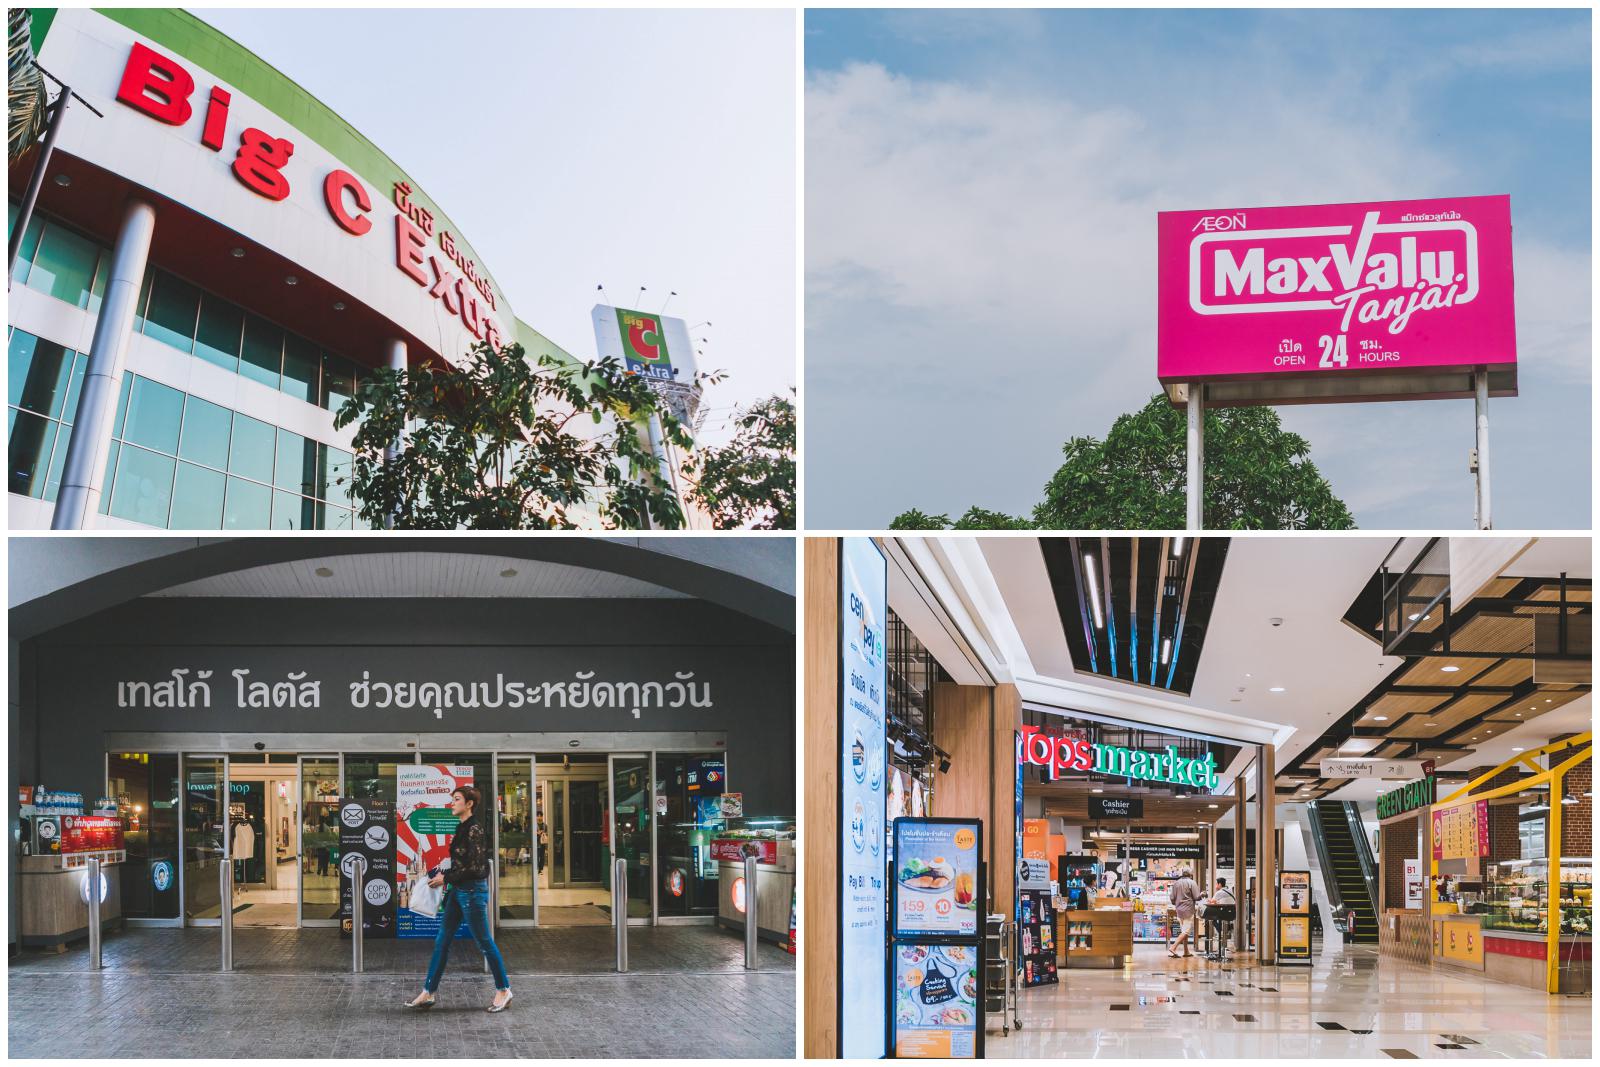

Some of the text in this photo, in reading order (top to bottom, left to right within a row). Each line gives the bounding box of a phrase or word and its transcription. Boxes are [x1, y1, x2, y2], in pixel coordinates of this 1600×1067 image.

[116, 41, 501, 355] Big C Extra
[1214, 211, 1455, 297] MaxValu
[1334, 273, 1464, 334] Tanjai
[1273, 351, 1400, 366] OPEN HOURS
[1279, 338, 1303, 353] เปิด
[1318, 334, 1348, 368] 24
[117, 668, 713, 719] เทสโก้ โลตัส ช่วยคุณประหยัดทุกวัน
[1093, 744, 1219, 789] market
[1102, 799, 1130, 808] Cashier
[1376, 776, 1434, 820] GREEN GIANT
[1027, 826, 1039, 834] GO
[1140, 859, 1146, 868] 1
[1407, 866, 1416, 874] B1
[903, 900, 949, 913] 159 10
